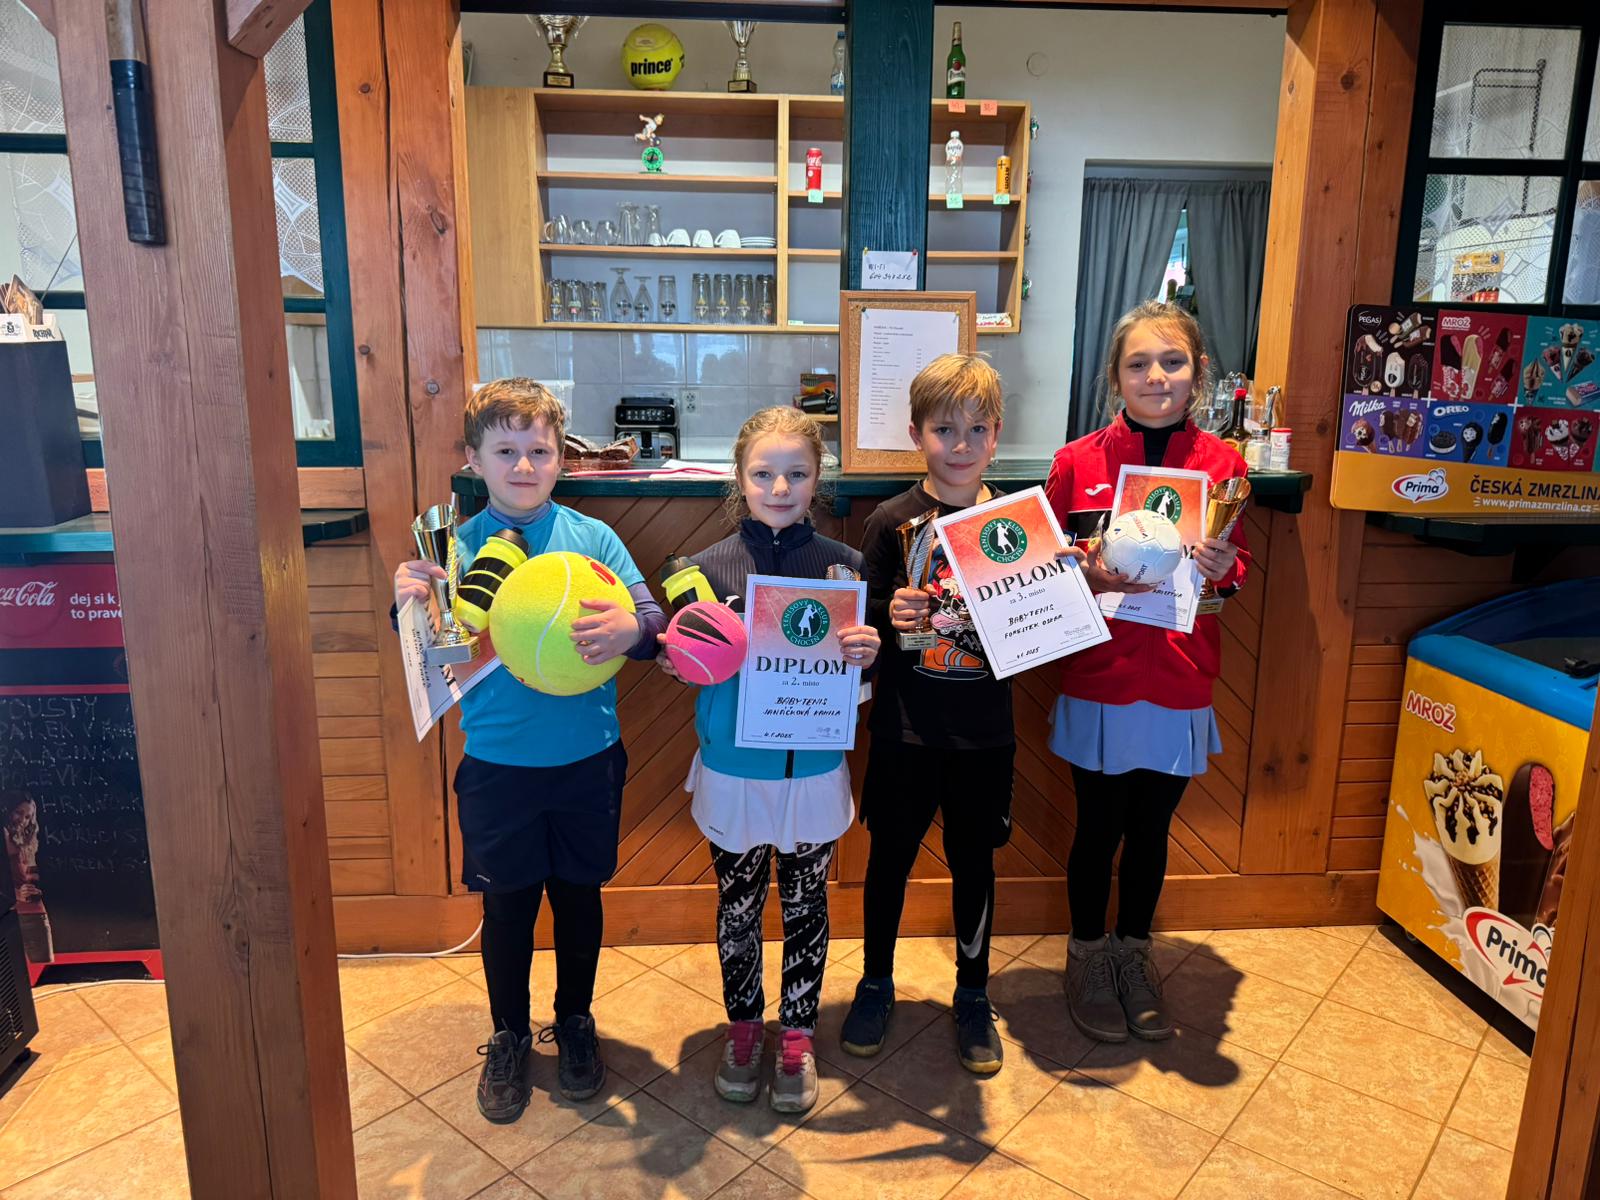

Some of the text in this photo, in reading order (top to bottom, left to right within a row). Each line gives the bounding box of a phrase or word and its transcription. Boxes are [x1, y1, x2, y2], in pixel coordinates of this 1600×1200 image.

[631, 58, 673, 77] prince
[1442, 316, 1471, 328] MROŽ
[1349, 399, 1386, 417] Milka
[1433, 405, 1470, 417] OREO
[1405, 481, 1440, 494] Prima
[1470, 475, 1600, 501] ČESKÁ ZMRZLIN
[1482, 498, 1592, 512] www.primazmrzlina.cz
[1008, 521, 1023, 535] KLUB
[976, 558, 1067, 602] DIPLOM
[70, 593, 116, 607] dej si k
[1017, 592, 1027, 602] 3.
[1028, 587, 1046, 598] místo
[70, 609, 85, 619] to
[756, 656, 848, 676] DIPLOM
[791, 677, 800, 686] 2.
[1406, 690, 1456, 733] MROŽ
